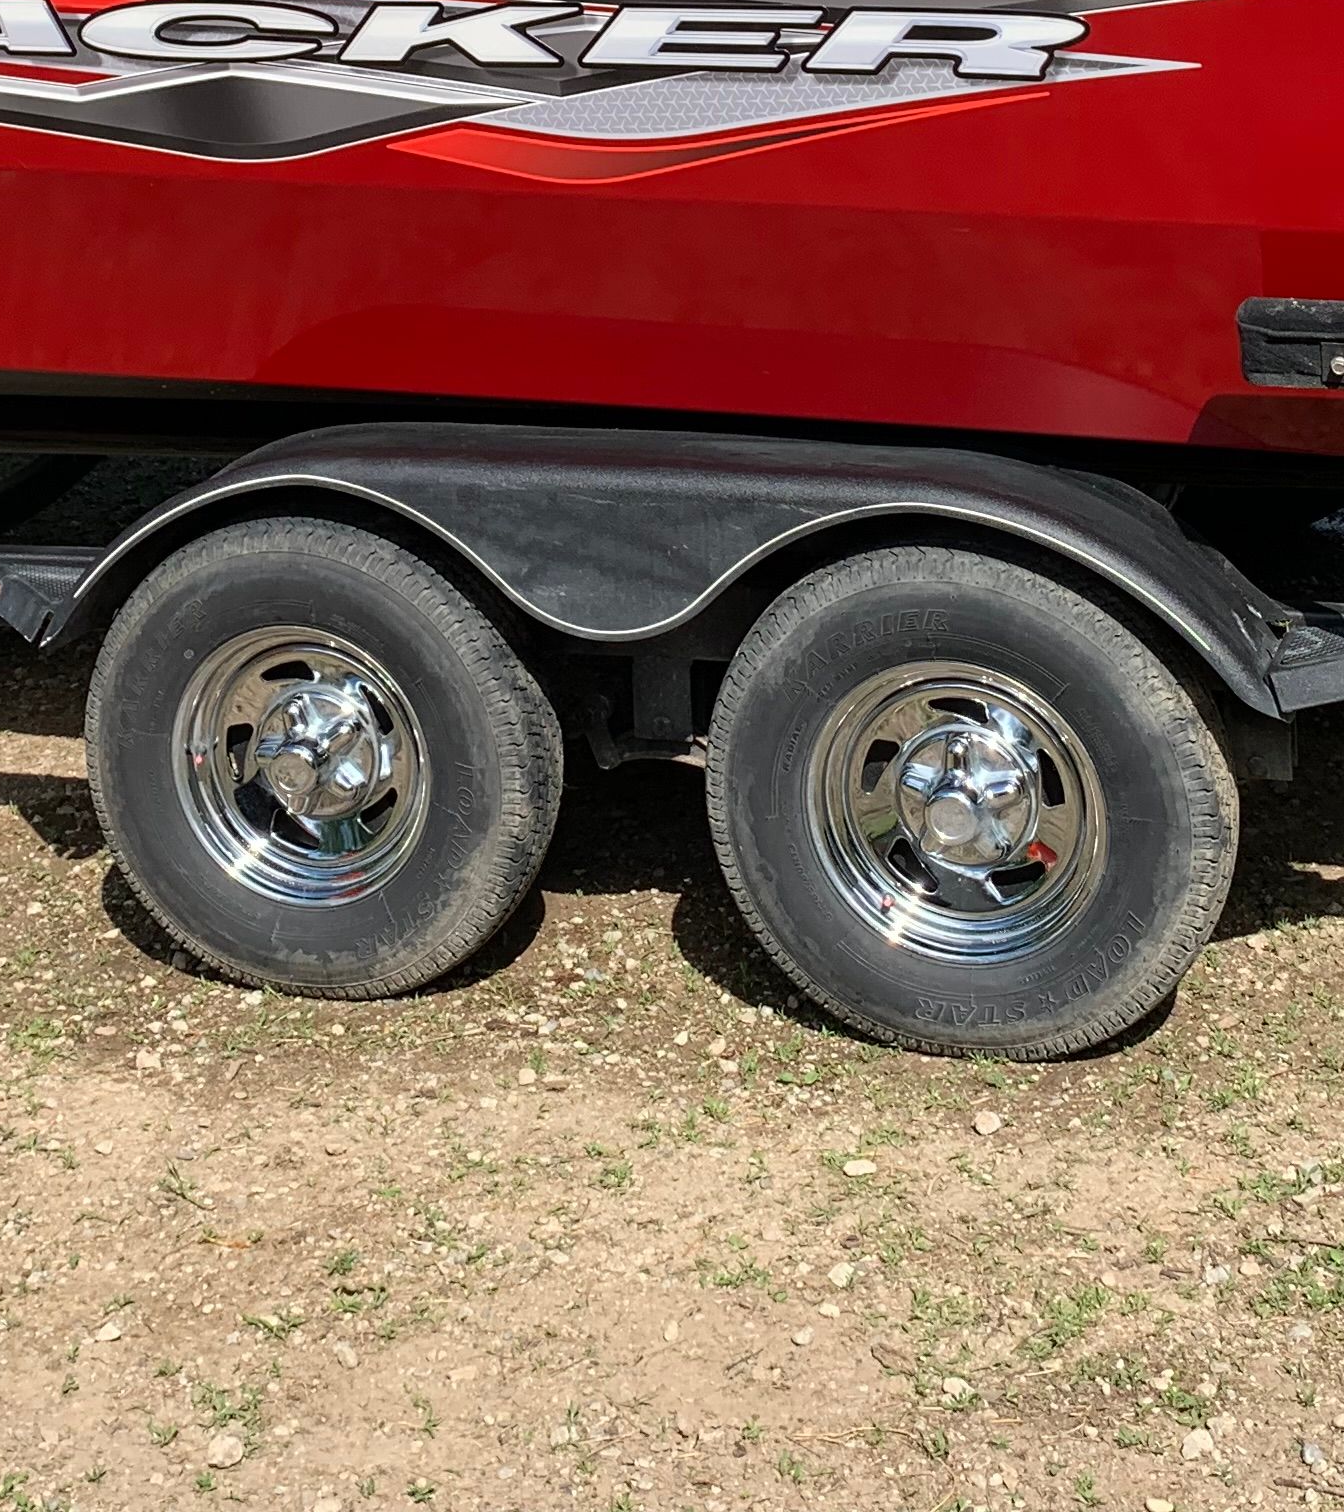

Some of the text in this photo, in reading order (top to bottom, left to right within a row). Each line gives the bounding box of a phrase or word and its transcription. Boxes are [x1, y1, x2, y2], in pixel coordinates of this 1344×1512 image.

[782, 607, 949, 704] KARRIER
[914, 909, 1146, 1028] LOAD STAR
